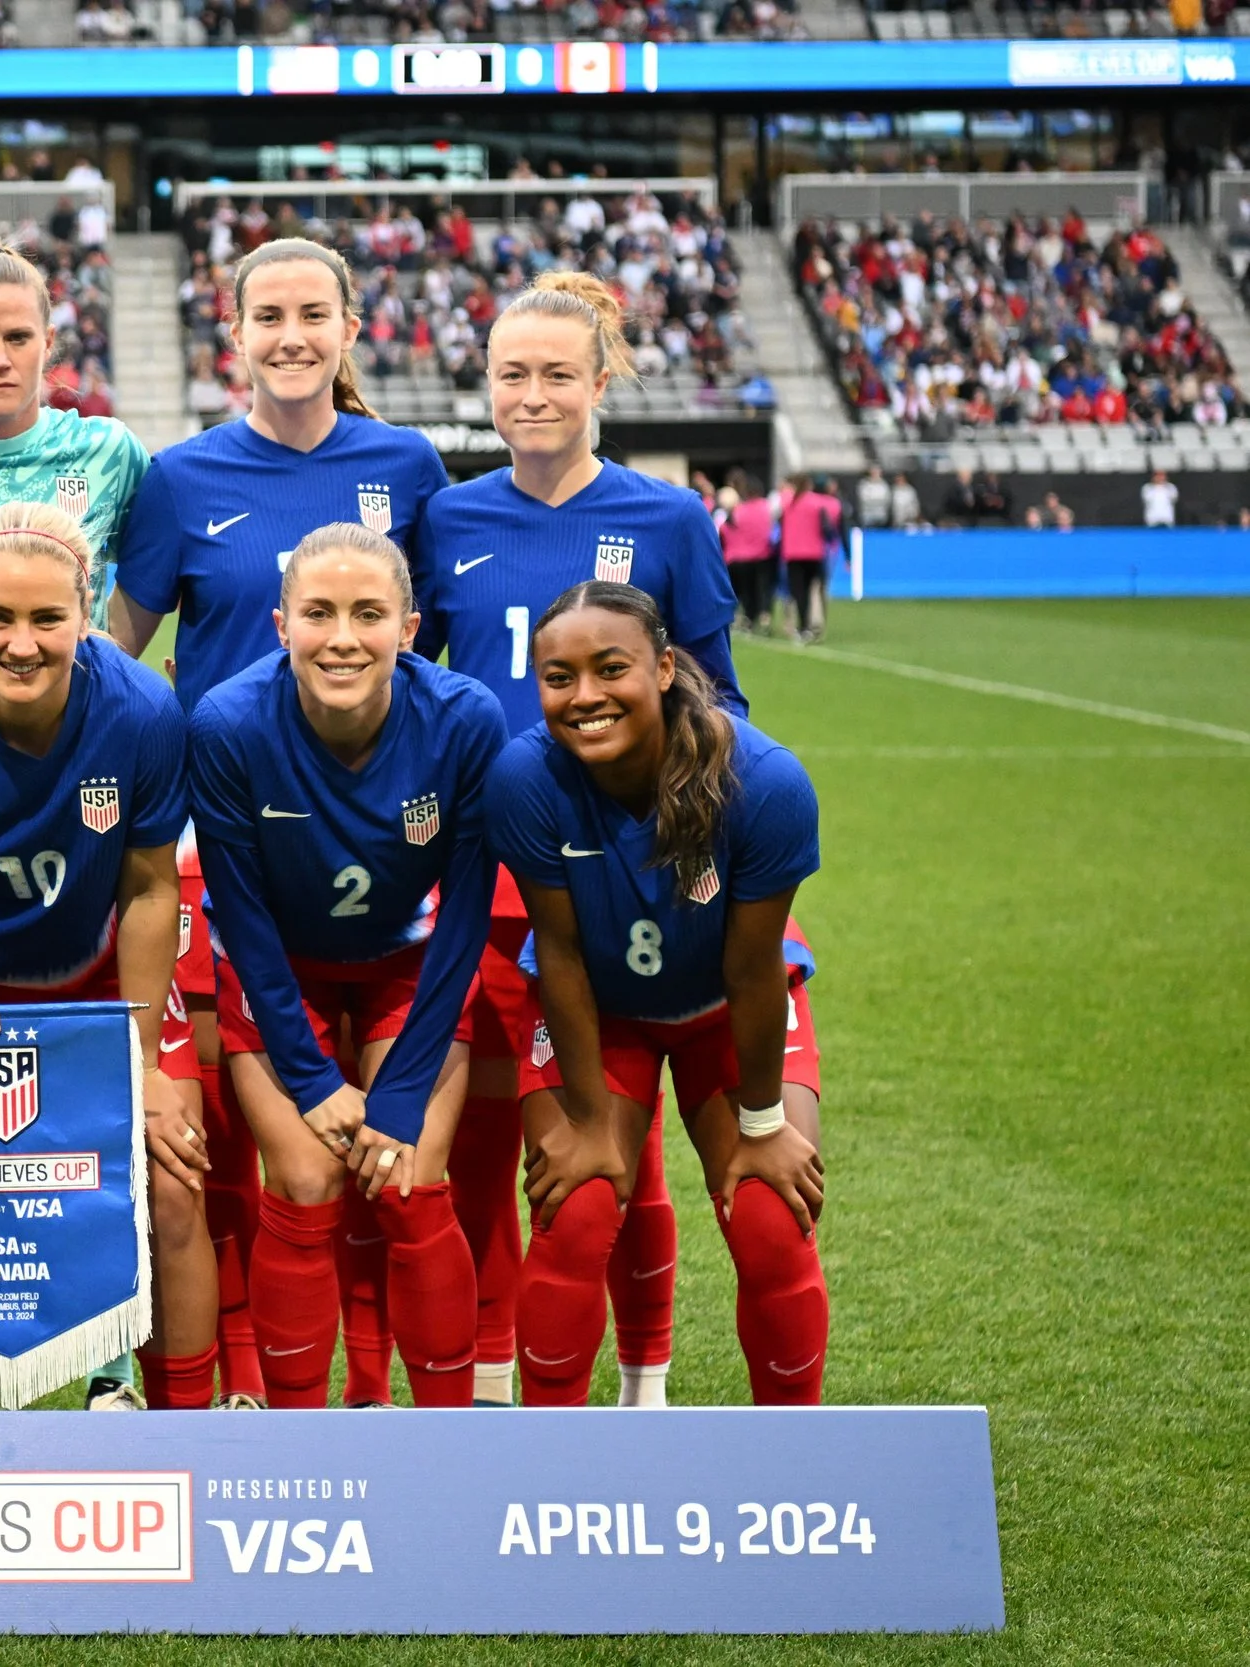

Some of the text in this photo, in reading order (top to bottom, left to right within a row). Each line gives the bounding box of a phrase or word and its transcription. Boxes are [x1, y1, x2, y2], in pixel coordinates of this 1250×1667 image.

[58, 479, 85, 496] USA
[361, 495, 388, 512] USA
[599, 547, 630, 565] USA
[82, 789, 117, 808] USA
[405, 803, 437, 824] USA
[329, 865, 372, 917] 2
[626, 919, 662, 976] 8
[54, 1162, 90, 1181] CUP
[8, 1198, 63, 1219] VISA
[20, 1292, 39, 1301] FIELD
[22, 1302, 38, 1310] OHIO
[16, 1312, 34, 1321] 2024
[207, 1479, 369, 1500] PRESENTED BY
[53, 1500, 165, 1554] CUP
[499, 1502, 876, 1563] APRIL 9, 2024
[205, 1519, 374, 1574] VISA
